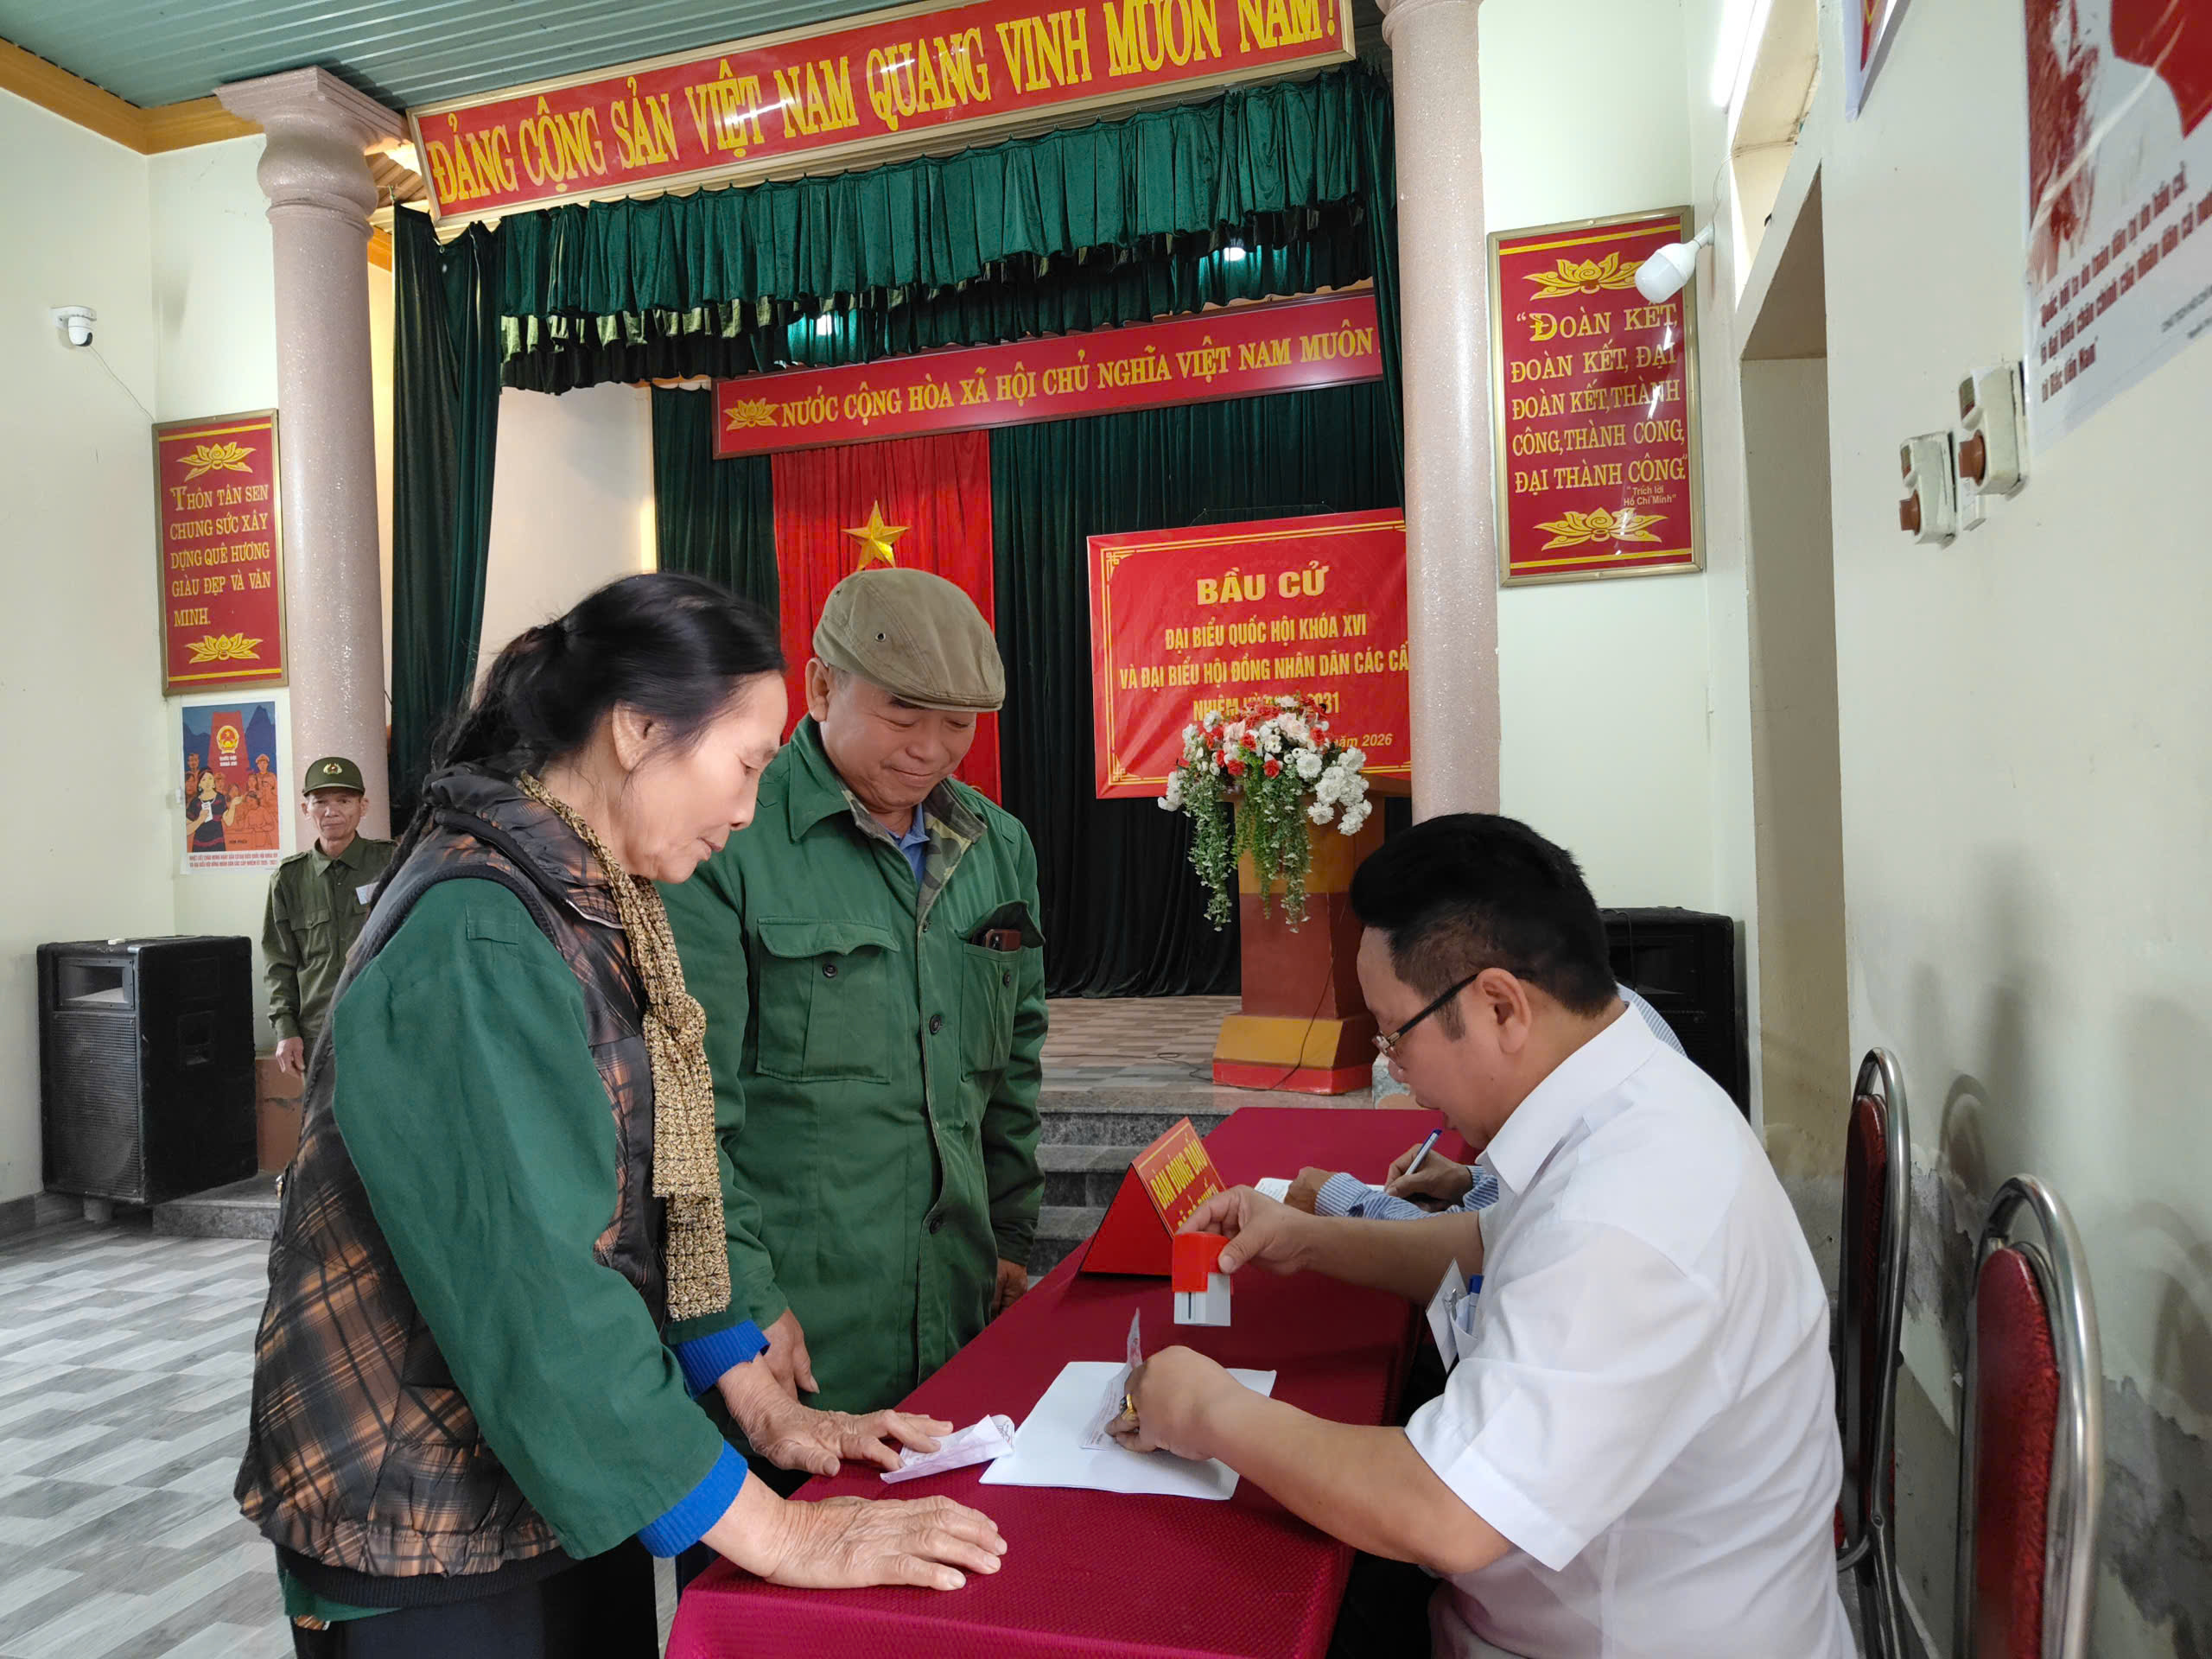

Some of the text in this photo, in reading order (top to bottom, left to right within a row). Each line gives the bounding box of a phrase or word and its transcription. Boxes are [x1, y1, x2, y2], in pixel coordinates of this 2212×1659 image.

[428, 112, 518, 204] ĐẢNG
[519, 96, 607, 193] CỘNG
[611, 77, 678, 169] SẢN
[685, 59, 764, 157] VIỆT
[774, 56, 860, 139] NAM
[866, 28, 991, 131] QUANG
[995, 9, 1092, 94] VINH
[780, 318, 1374, 428] NƯỚC CỘNG HÒA XÃ HỘI CHỦ NGHĨA VIỆT NAM MUÔN
[1510, 339, 1677, 384] ĐOÀN KẾT, ĐẠI
[1512, 376, 1681, 421] ĐOÀN KẾT, THÀNH
[1512, 416, 1685, 456] CÔNG, THÀNH CÔNG,
[169, 483, 269, 512] THÔN TÂN SEN
[1515, 468, 1548, 496] ĐẠI
[1554, 459, 1622, 490] THÀNH
[169, 509, 269, 540] CHUNG SỨC XÂY
[170, 541, 270, 571] DỰNG QUÊ HƯƠNG
[172, 568, 271, 597] GIÀU ĐẸP VÀ VĂN
[1197, 560, 1330, 606] BẦU CỬ
[174, 607, 211, 627] MINH.
[1165, 612, 1367, 654] ĐẠI BIỂU QUỐC HỘI KHÓA XVI
[1120, 641, 1409, 692] VÀ ĐẠI BIỂU HỘI ĐỒNG NHÂN DÂN CÁC CẤ
[1362, 733, 1394, 747] 2026
[1150, 1168, 1178, 1211] BÀN
